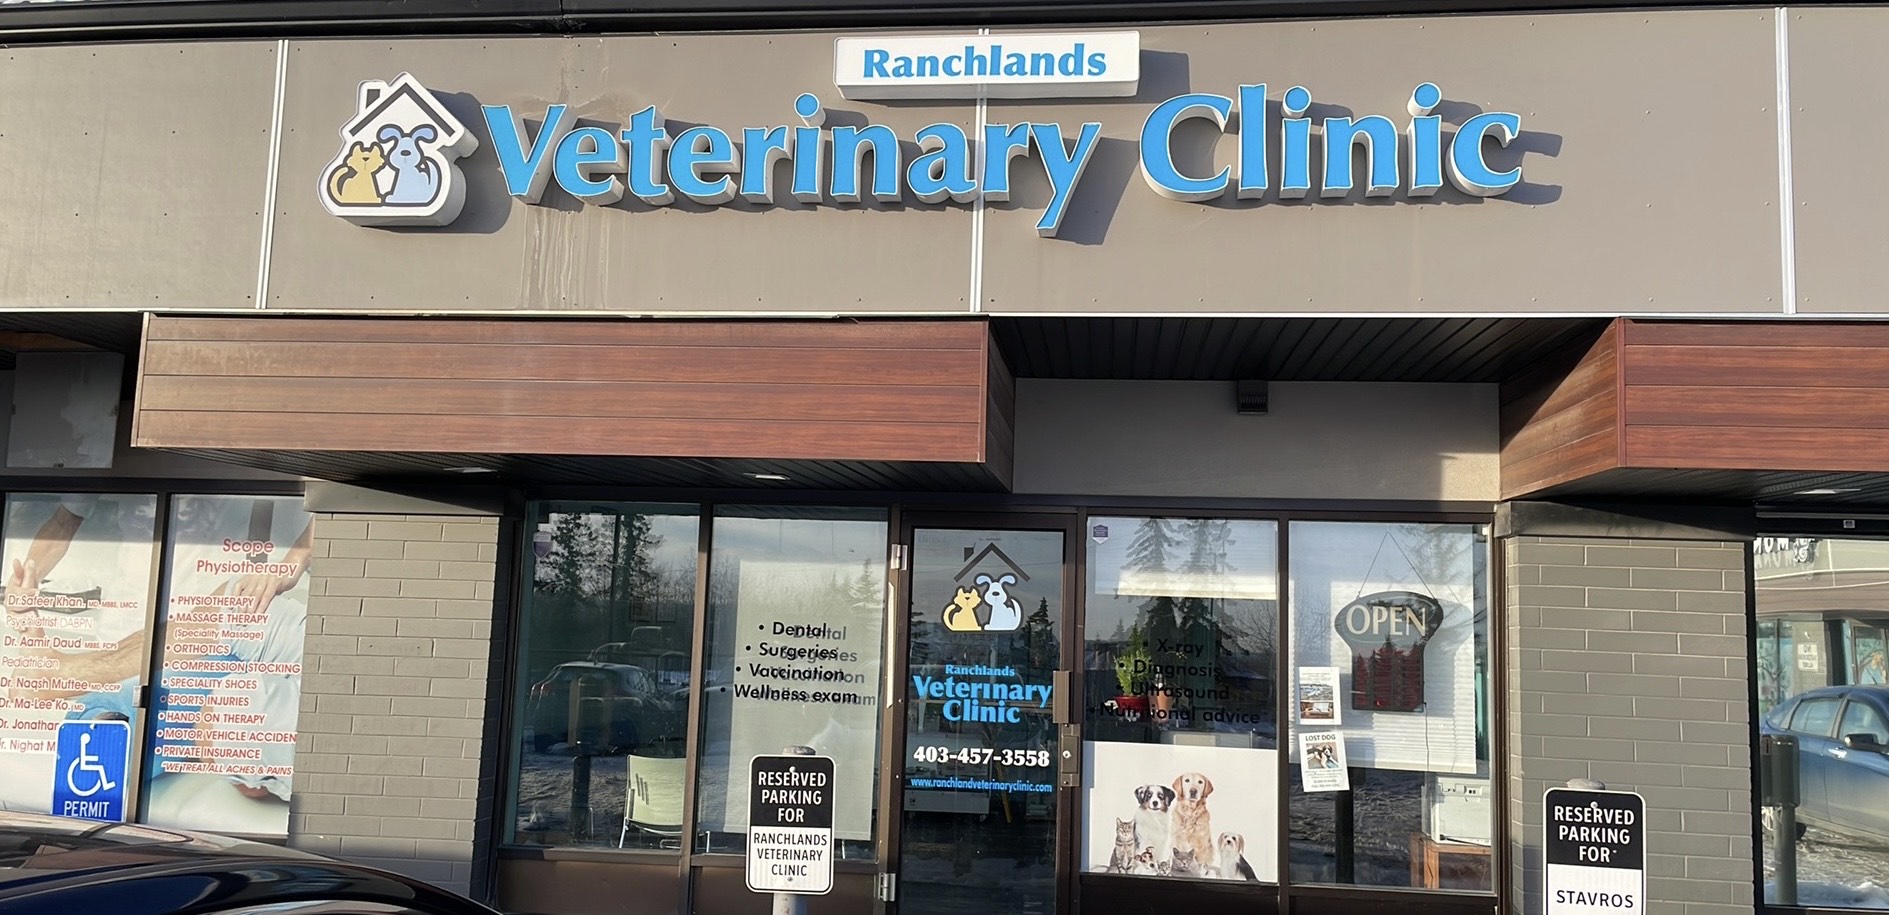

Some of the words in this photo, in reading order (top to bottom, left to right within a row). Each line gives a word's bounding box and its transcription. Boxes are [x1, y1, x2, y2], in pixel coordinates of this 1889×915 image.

[862, 43, 1107, 78] Ranchlands
[481, 92, 1103, 233] Veterinary
[1139, 81, 1523, 194] Clinic
[222, 539, 274, 556] Scope
[196, 560, 298, 577] Physiotherapy
[177, 596, 254, 606] PHYSIOTHERAPY
[6, 616, 58, 628] Psychiatrist
[176, 613, 224, 623] MASSAGE
[227, 614, 269, 624] THERAPY
[1346, 604, 1426, 636] OPEN
[174, 629, 219, 639] (Speciality
[221, 630, 264, 640] Massage)
[772, 622, 827, 635] Dental
[4, 636, 17, 646] Dr.
[20, 637, 49, 647] Aamir
[53, 638, 82, 648] Daud
[173, 644, 230, 654] ORTHOTICS
[1157, 638, 1204, 657] X-ray
[759, 642, 838, 660] Surgeries
[1, 657, 59, 668] Pediatrician
[171, 661, 245, 671] COMPRESSION
[248, 663, 301, 673] STOCKING
[945, 664, 1016, 677] Ranchlands
[1133, 659, 1220, 678] Diagnosis
[749, 663, 845, 681] Vaccination
[0, 677, 14, 687] Dr.
[16, 678, 49, 691] Naqsh
[170, 678, 222, 688] SPECIALITY
[225, 680, 257, 689] SHOES
[1130, 681, 1230, 701] Ultrasound
[168, 695, 205, 705] SPORTS
[207, 696, 250, 706] INJURIES
[734, 684, 806, 699] Wellness
[812, 690, 858, 703] exam
[0, 697, 11, 708] Dr.
[14, 698, 53, 709] Ma-Lee
[942, 698, 1021, 724] Clinic
[166, 713, 201, 722] HANDS
[203, 713, 220, 722] ON
[223, 714, 266, 724] THERAPY
[1202, 708, 1261, 725] advice
[165, 730, 203, 739] MOTOR
[206, 731, 247, 741] VEHICLE
[9, 739, 44, 753] Nighat
[163, 747, 201, 757] PRIVATE
[203, 748, 261, 758] INSURANCE
[913, 746, 1050, 767] 403-457-3558
[182, 764, 207, 772] TREAT
[207, 765, 223, 773] ALL
[225, 765, 255, 773] ACHES
[266, 767, 292, 775] PAINS
[758, 771, 827, 787] RESERVED
[910, 777, 1053, 794] www.ranchlandveterinaryclinic.com
[761, 789, 822, 806] PARKING
[63, 801, 110, 818] PERMIT
[777, 807, 805, 823] FOR
[1554, 805, 1635, 826] RESERVED
[753, 832, 828, 846] RANCHLANDS
[1559, 825, 1631, 845] PARKING
[757, 848, 823, 861] VETERINARY
[1579, 845, 1611, 863] FOR
[771, 864, 808, 877] CLINIC
[1556, 889, 1634, 909] STAVROS
